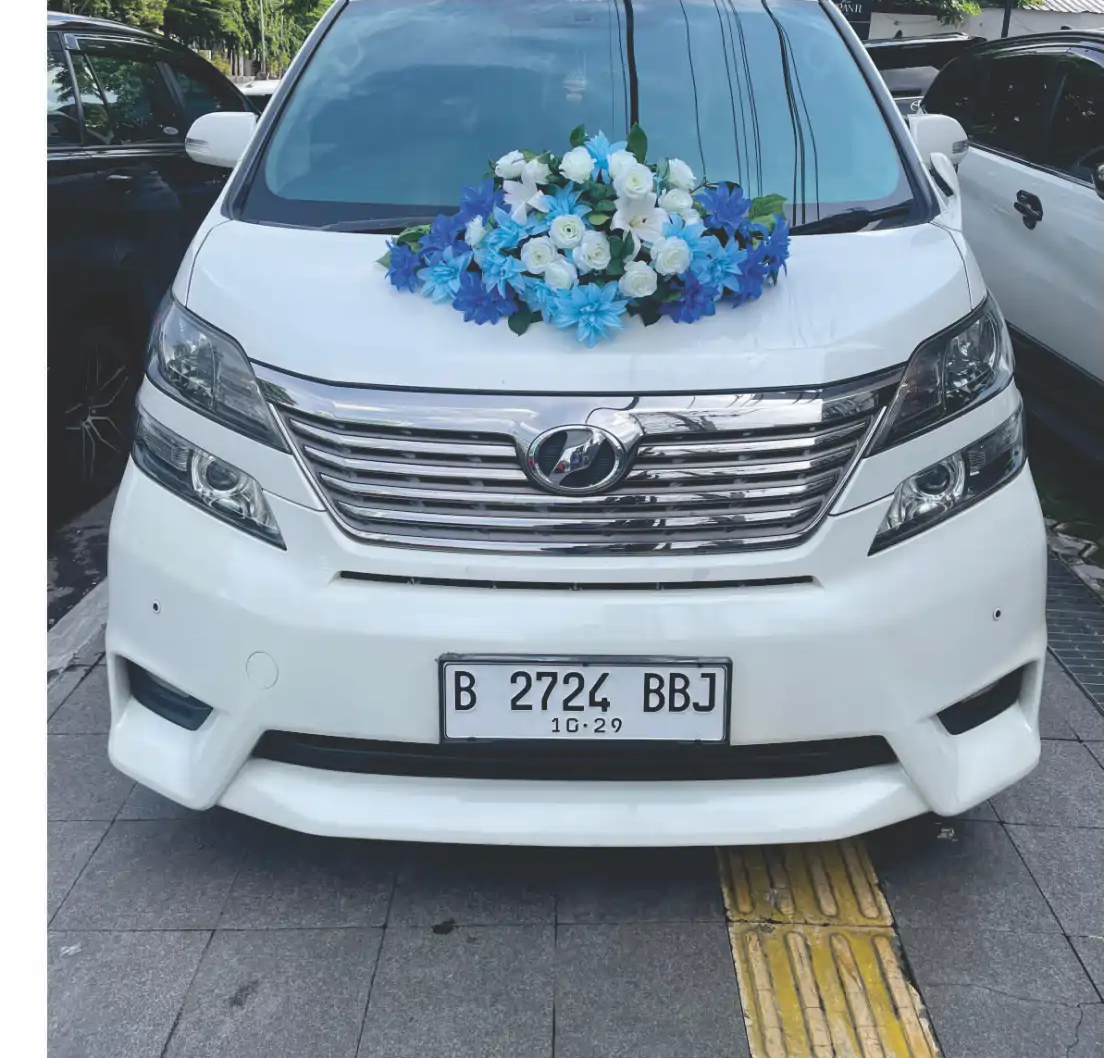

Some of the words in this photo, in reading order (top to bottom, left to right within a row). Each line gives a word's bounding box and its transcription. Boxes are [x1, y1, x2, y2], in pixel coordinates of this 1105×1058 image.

[454, 670, 477, 711] B
[510, 670, 611, 713] 2724
[643, 672, 717, 713] BBJ
